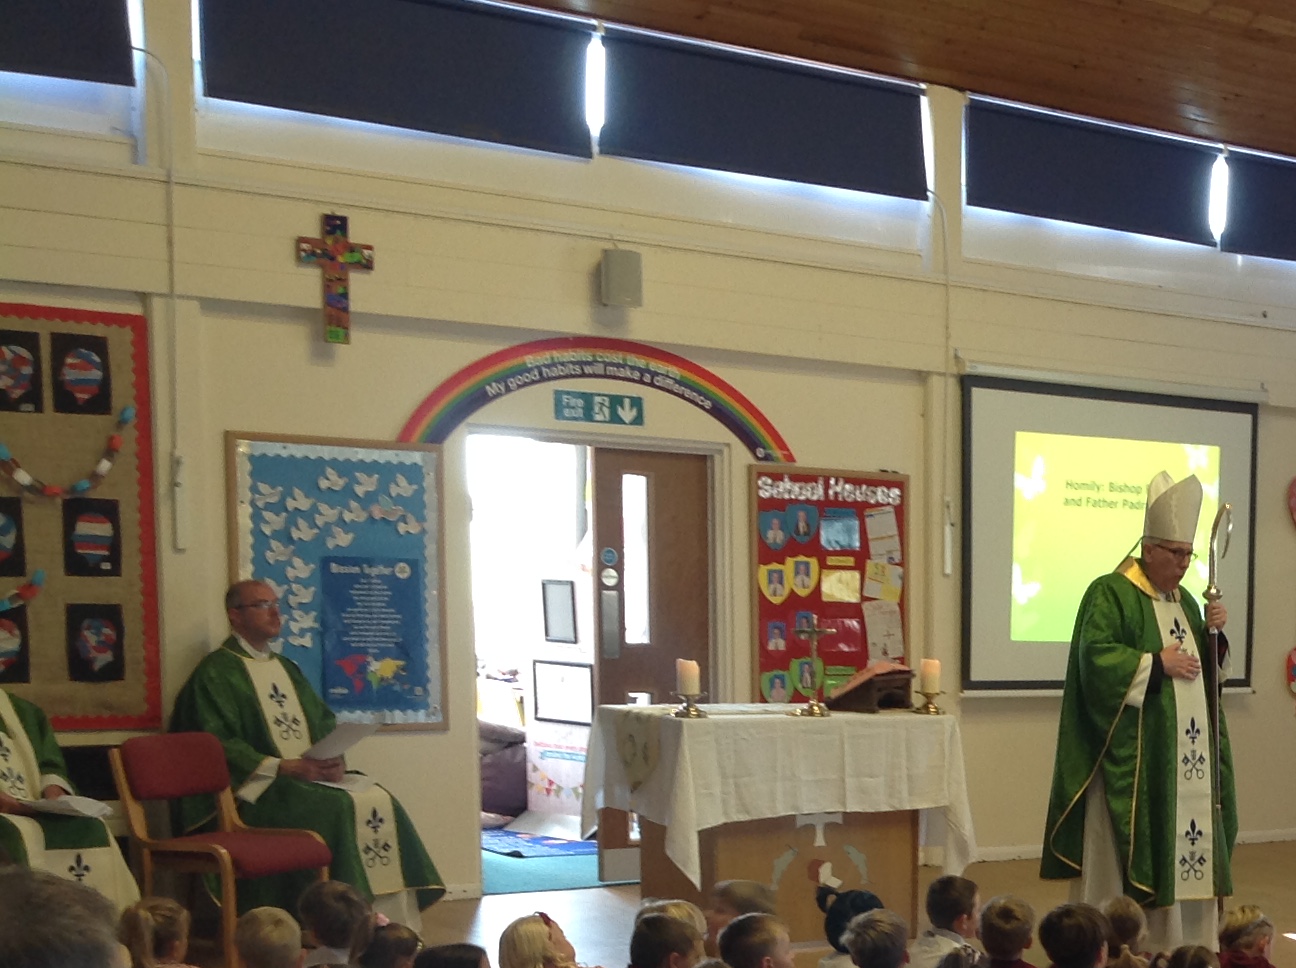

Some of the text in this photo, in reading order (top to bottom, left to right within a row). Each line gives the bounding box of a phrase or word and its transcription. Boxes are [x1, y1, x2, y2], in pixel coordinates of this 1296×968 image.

[552, 349, 593, 362] habits
[485, 360, 713, 410] My good habits will make a difference
[562, 395, 584, 408] Fire
[563, 407, 584, 418] exit
[757, 474, 902, 506] School Houses
[1108, 482, 1143, 496] Bishop
[1064, 497, 1082, 507] and
[1086, 497, 1119, 509] Father
